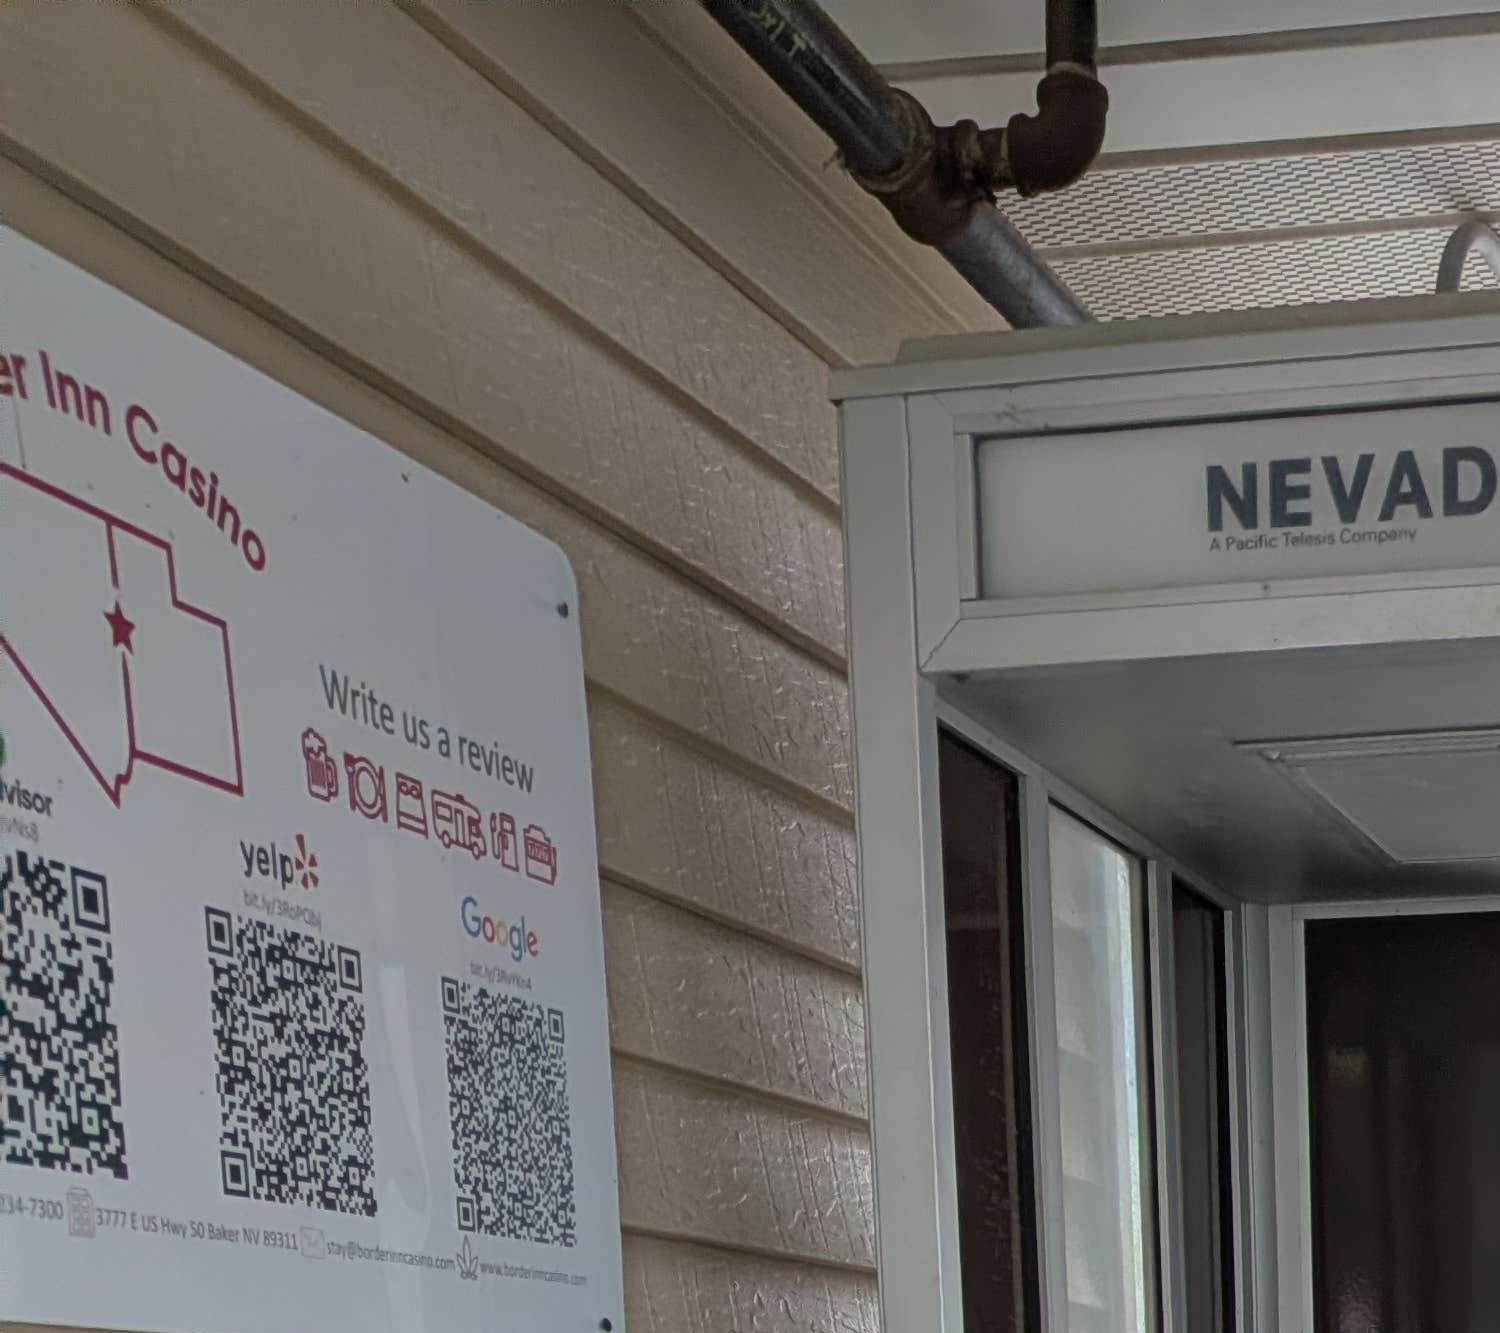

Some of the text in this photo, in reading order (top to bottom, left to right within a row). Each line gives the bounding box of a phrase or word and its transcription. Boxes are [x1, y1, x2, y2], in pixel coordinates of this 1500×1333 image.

[39, 350, 111, 436] Inn
[126, 404, 267, 571] Casino
[1210, 528, 1417, 551] A Pacific Telesis Company
[319, 664, 535, 793] Write us a review
[0, 776, 53, 816] visor
[240, 840, 294, 891] yelp
[461, 896, 539, 963] Google
[96, 1208, 298, 1250] 3777 E US Hwy 50 Baker NV 89311
